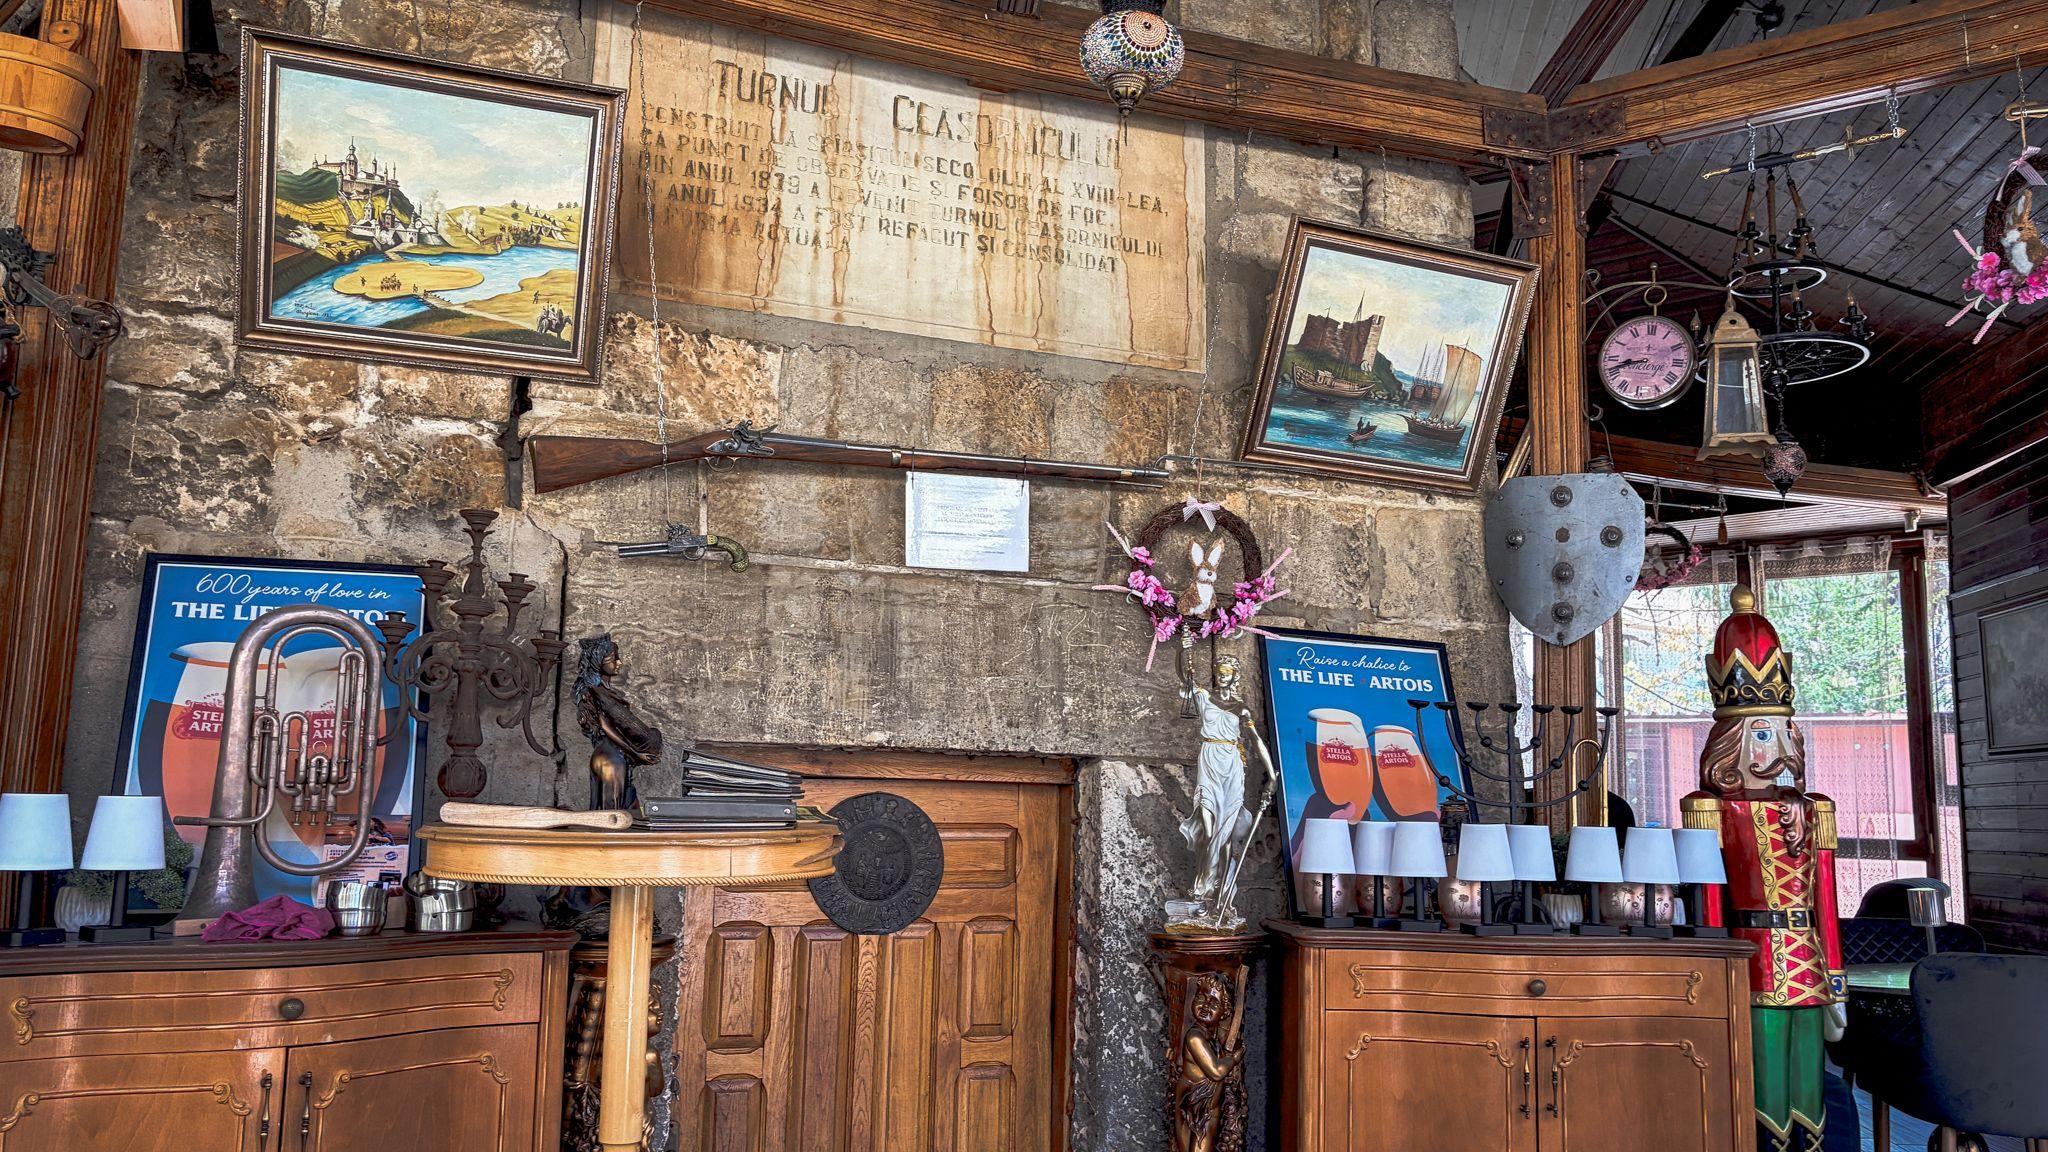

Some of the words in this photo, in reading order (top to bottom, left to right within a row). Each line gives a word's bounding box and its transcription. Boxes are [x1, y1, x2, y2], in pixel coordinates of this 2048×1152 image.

[712, 59, 832, 115] TURNUL
[643, 102, 763, 141] CONSTRUIT
[666, 183, 725, 209] ANUL
[792, 204, 805, 221] A
[682, 159, 741, 186] ANUL
[808, 181, 822, 199] A
[928, 202, 1006, 232] TURNUL
[196, 573, 251, 595] 600
[241, 584, 303, 604] years
[304, 582, 329, 603] of
[329, 582, 366, 599] love
[367, 587, 392, 600] in
[171, 601, 226, 620] THE
[1296, 646, 1341, 670] Raise
[1352, 655, 1397, 671] chalice
[1398, 660, 1411, 672] to
[1278, 667, 1314, 683] THE
[1317, 672, 1355, 687] LIFE
[1369, 675, 1434, 692] ARTOIS
[1326, 747, 1351, 755] STELLA
[1326, 753, 1352, 761] ARTOIS
